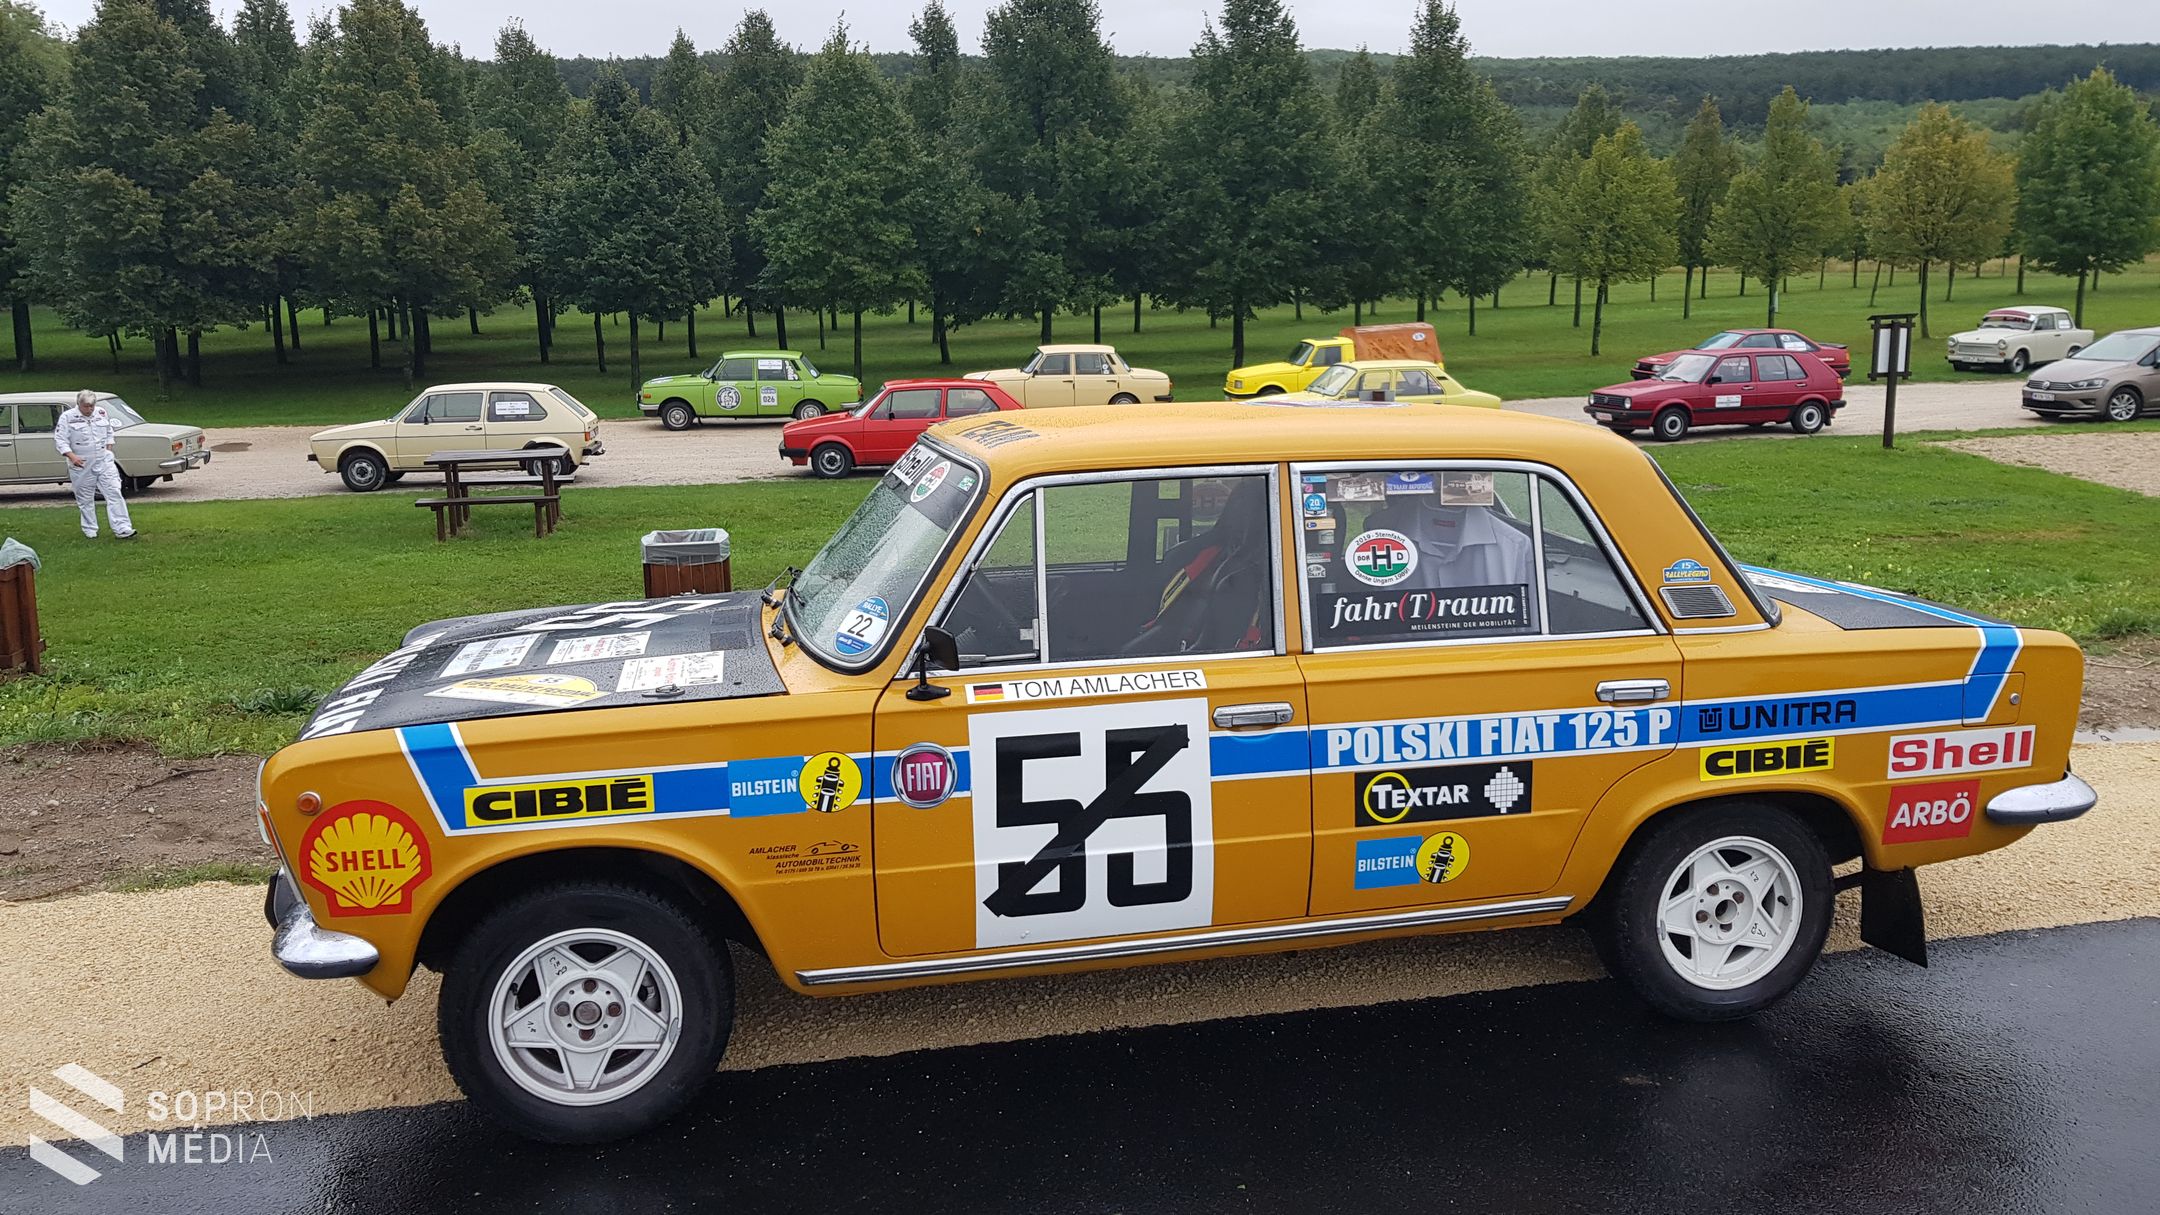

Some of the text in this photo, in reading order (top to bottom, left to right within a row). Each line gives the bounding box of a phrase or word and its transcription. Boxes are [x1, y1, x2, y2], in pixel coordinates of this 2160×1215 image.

[1354, 534, 1371, 546] 2019
[1375, 532, 1406, 544] Sternfahrt
[1371, 545, 1392, 570] H
[1397, 552, 1404, 560] D
[1354, 570, 1372, 582] Danke
[1330, 591, 1516, 629] fahr(T)raum
[847, 614, 873, 638] 22
[1411, 618, 1516, 631] MEILENSTEINE DER MOBILITÄT
[1008, 671, 1202, 700] TOM AMLACHER
[1728, 699, 1858, 732] UNITRA
[1327, 708, 1672, 766] POLSKI FIAT 125 P
[1891, 729, 2032, 774] Shell
[731, 778, 798, 798] BILSTEIN
[906, 760, 944, 792] FIAT
[1891, 791, 1971, 829] ARBÖ
[326, 848, 406, 872] SHELL
[748, 845, 797, 855] AMLACHER
[1358, 854, 1414, 873] BILSTEIN
